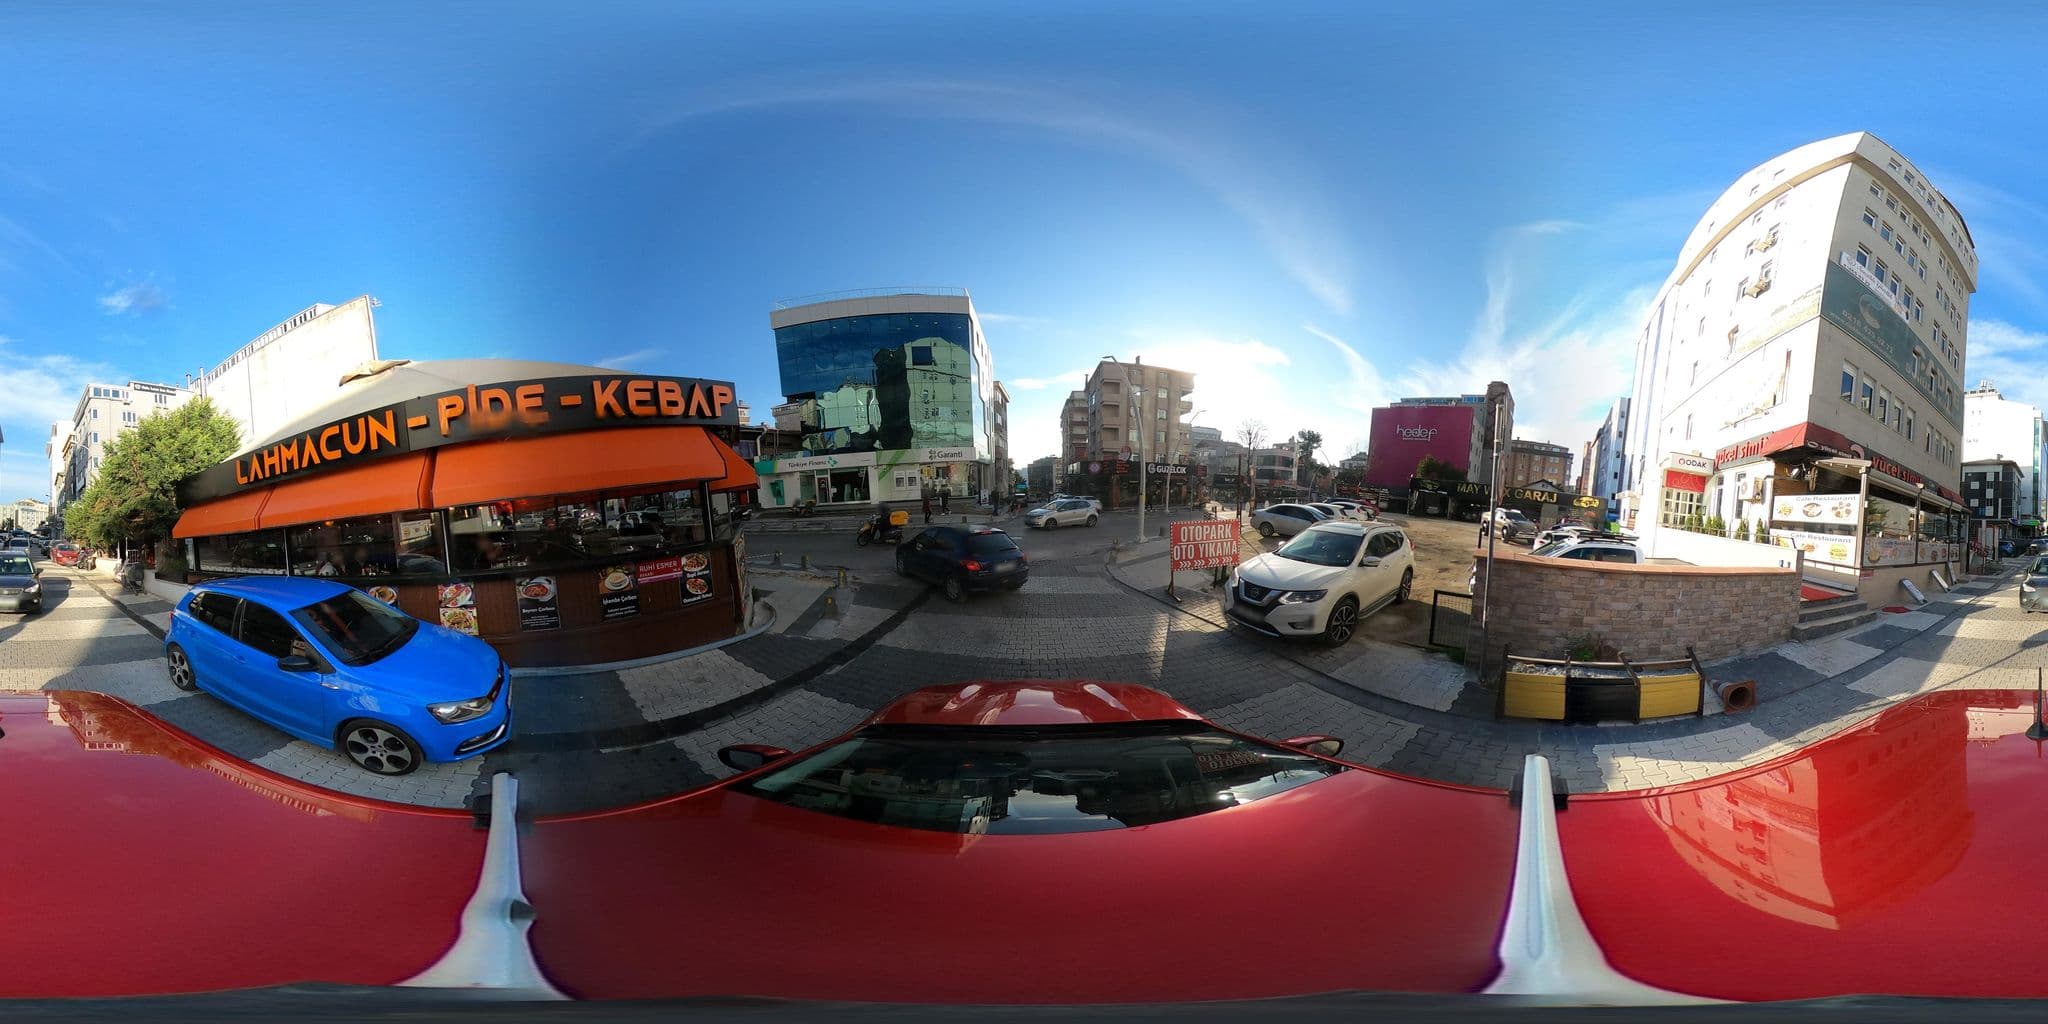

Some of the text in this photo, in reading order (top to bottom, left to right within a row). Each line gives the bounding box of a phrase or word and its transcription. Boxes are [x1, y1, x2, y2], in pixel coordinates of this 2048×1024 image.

[235, 409, 397, 486] LAHMACUN
[436, 383, 550, 436] PİDE
[592, 379, 734, 418] KEBAP
[1396, 424, 1438, 442] hedef
[936, 450, 963, 459] Garanti
[1514, 488, 1558, 504] GARAJ
[1180, 523, 1232, 542] OTOPARK
[1173, 540, 1238, 561] OTO YIKAMA
